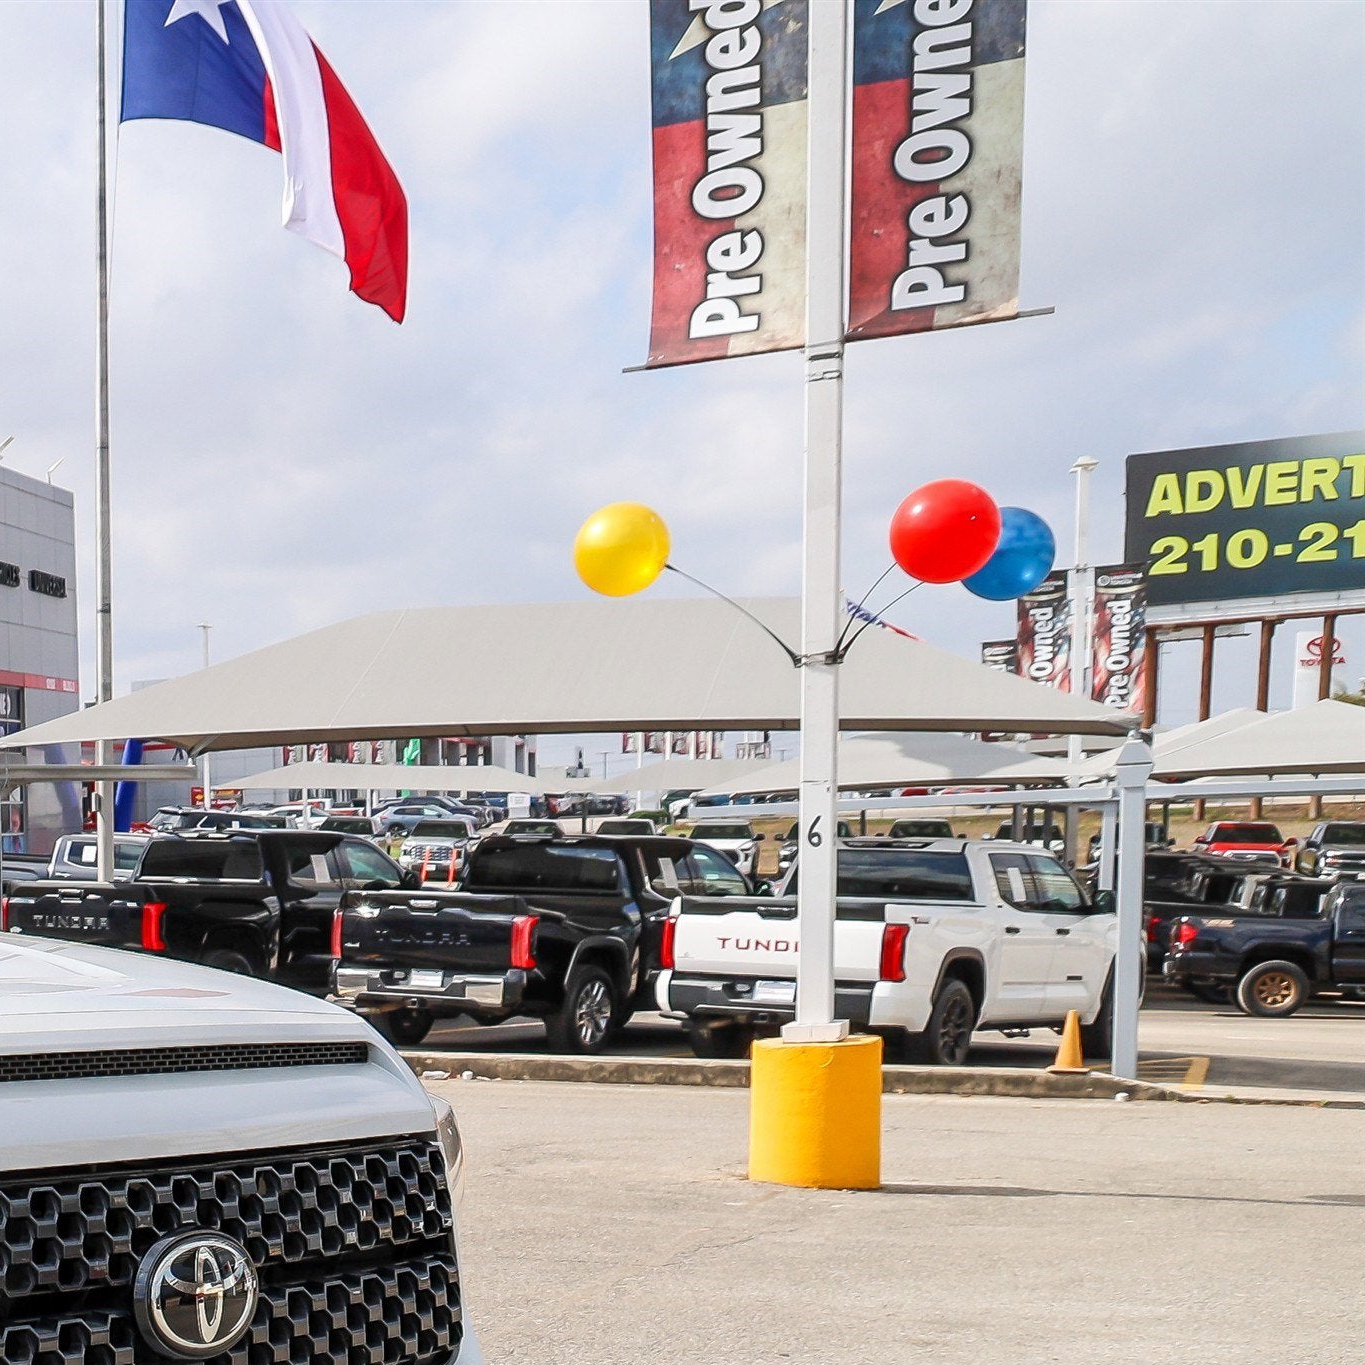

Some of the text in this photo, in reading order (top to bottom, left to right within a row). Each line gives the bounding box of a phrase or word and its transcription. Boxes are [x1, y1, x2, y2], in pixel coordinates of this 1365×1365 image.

[689, 0, 764, 339] Pre Owned
[891, 193, 970, 310] Pre
[1029, 606, 1054, 677] Owned
[1105, 599, 1132, 671] Owned
[807, 814, 822, 848] 6
[717, 937, 799, 952] TUND
